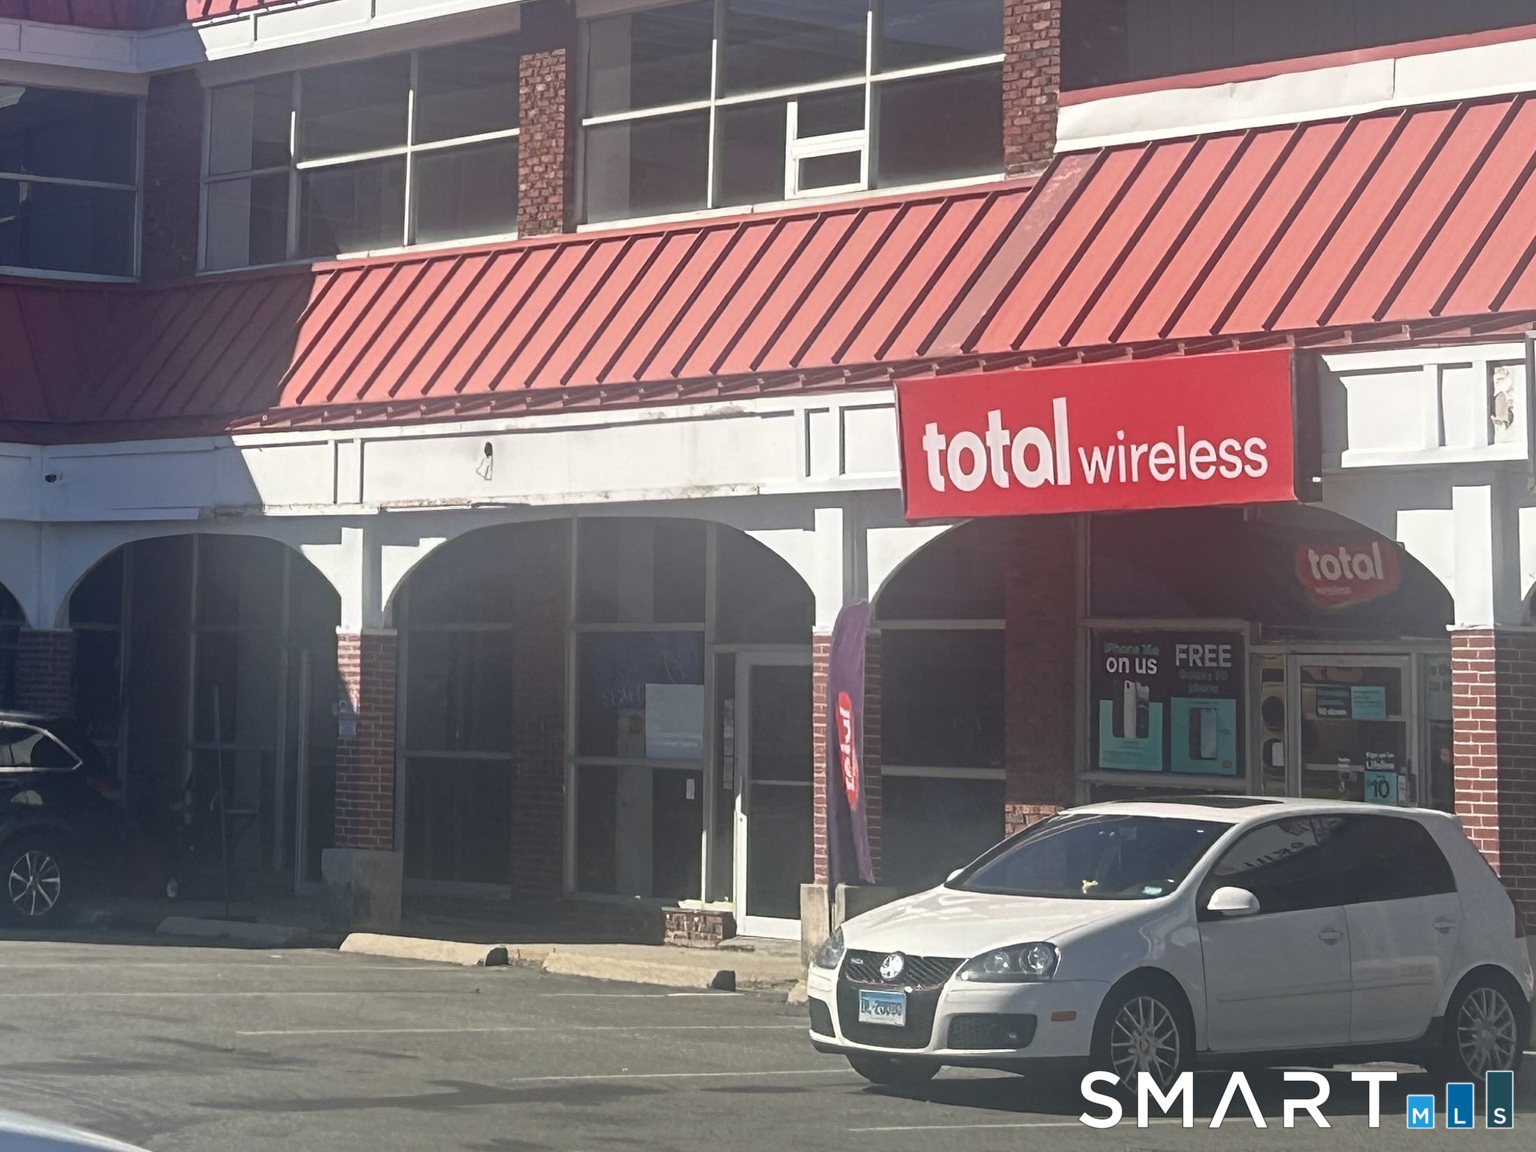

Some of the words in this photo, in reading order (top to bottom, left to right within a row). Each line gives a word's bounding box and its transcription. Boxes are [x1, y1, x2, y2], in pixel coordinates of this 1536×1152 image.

[923, 397, 1071, 492] total
[1078, 425, 1269, 485] wireless
[1308, 542, 1384, 581] total
[1106, 656, 1130, 674] on
[1135, 657, 1158, 675] us
[1175, 644, 1232, 668] FREE
